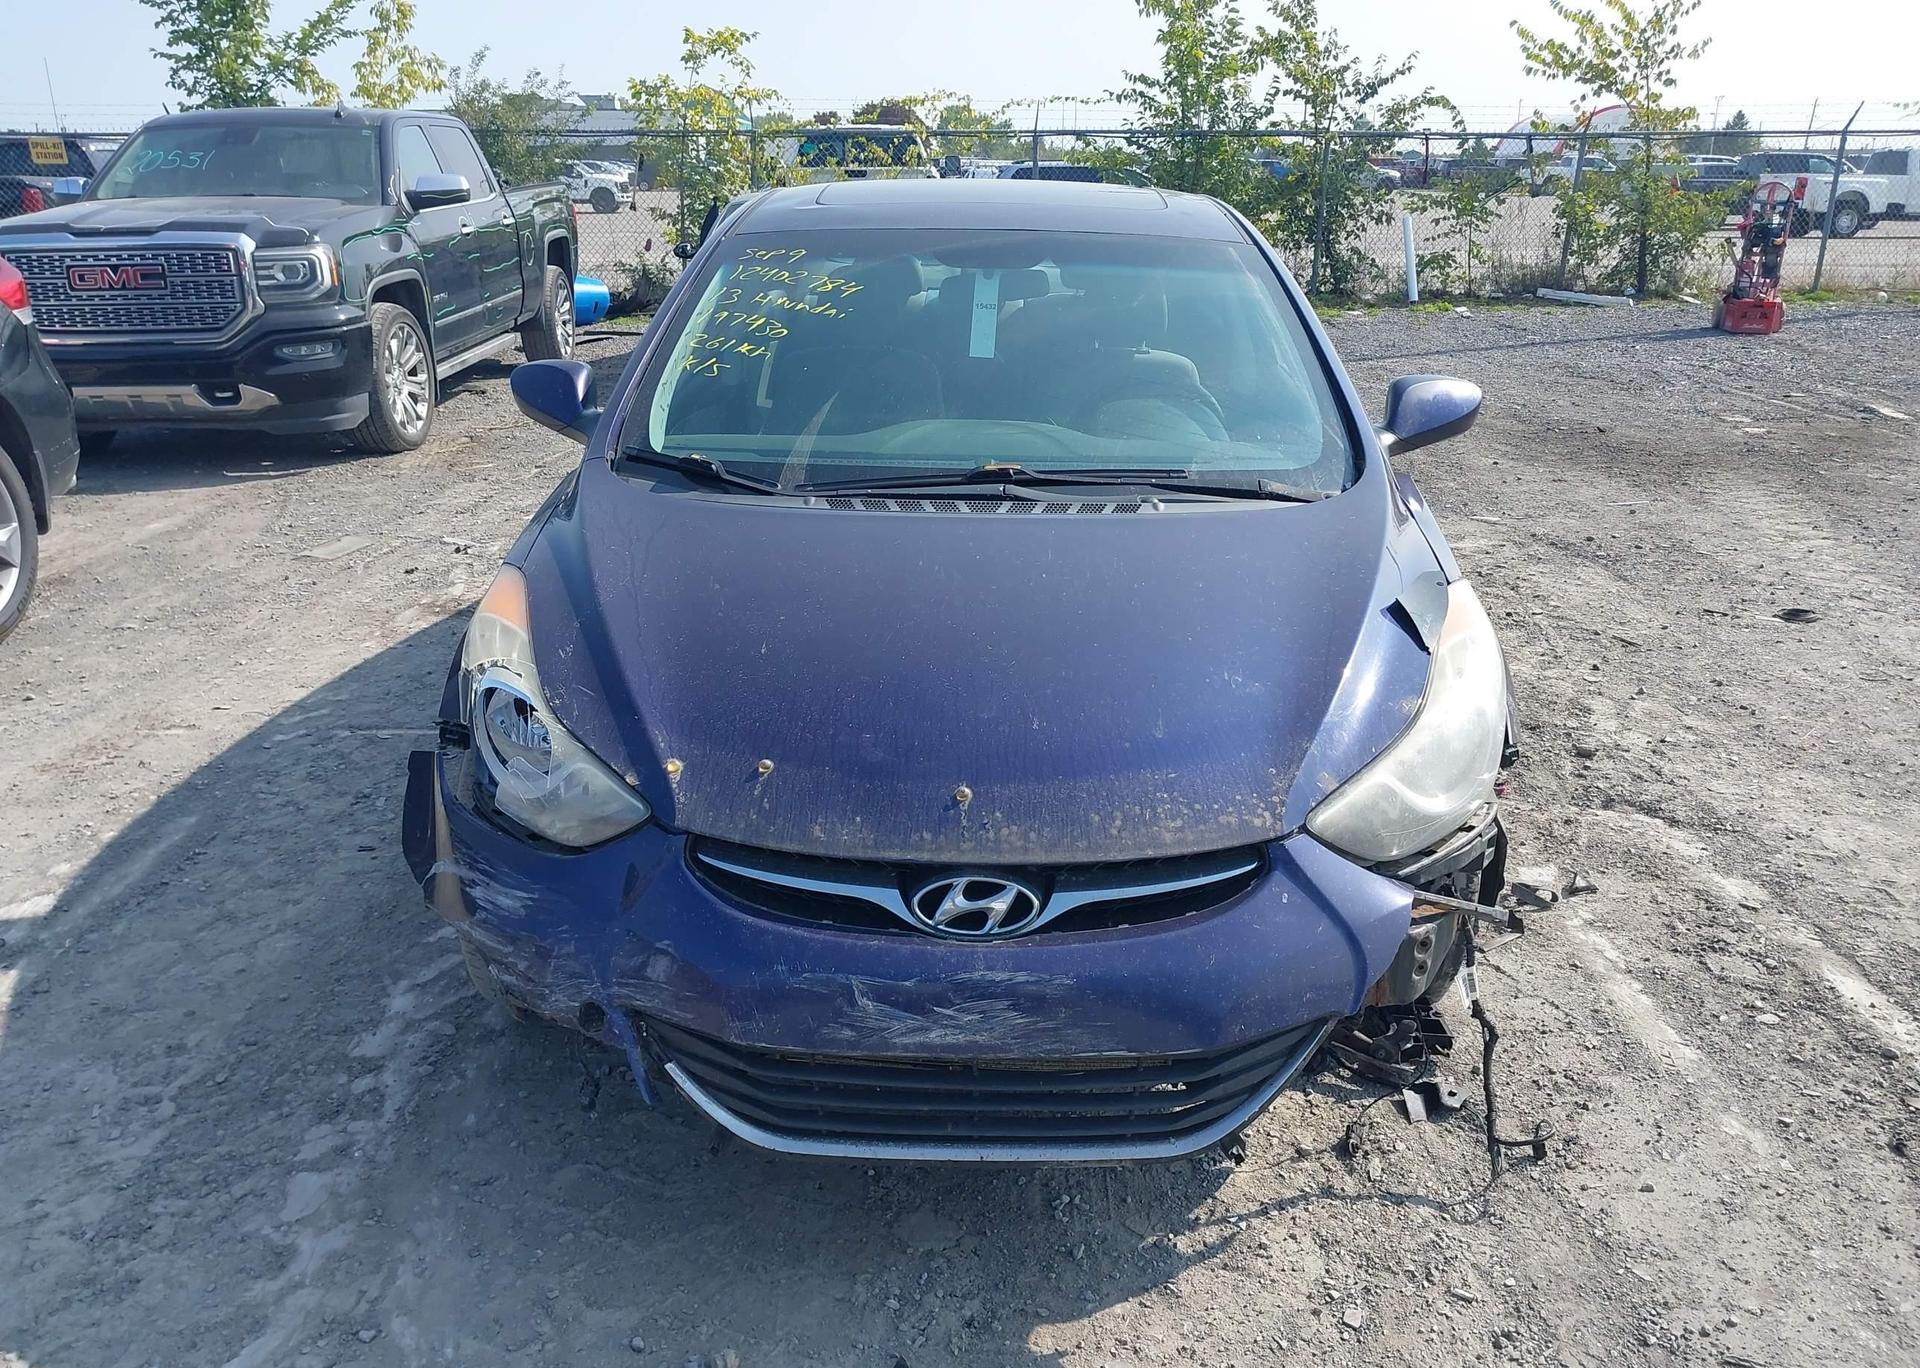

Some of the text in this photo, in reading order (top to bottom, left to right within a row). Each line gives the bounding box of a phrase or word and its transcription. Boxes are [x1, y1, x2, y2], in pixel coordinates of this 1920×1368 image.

[35, 151, 65, 160] STATION
[786, 248, 808, 264] 9
[69, 265, 165, 289] GMC
[975, 302, 997, 310] 15432
